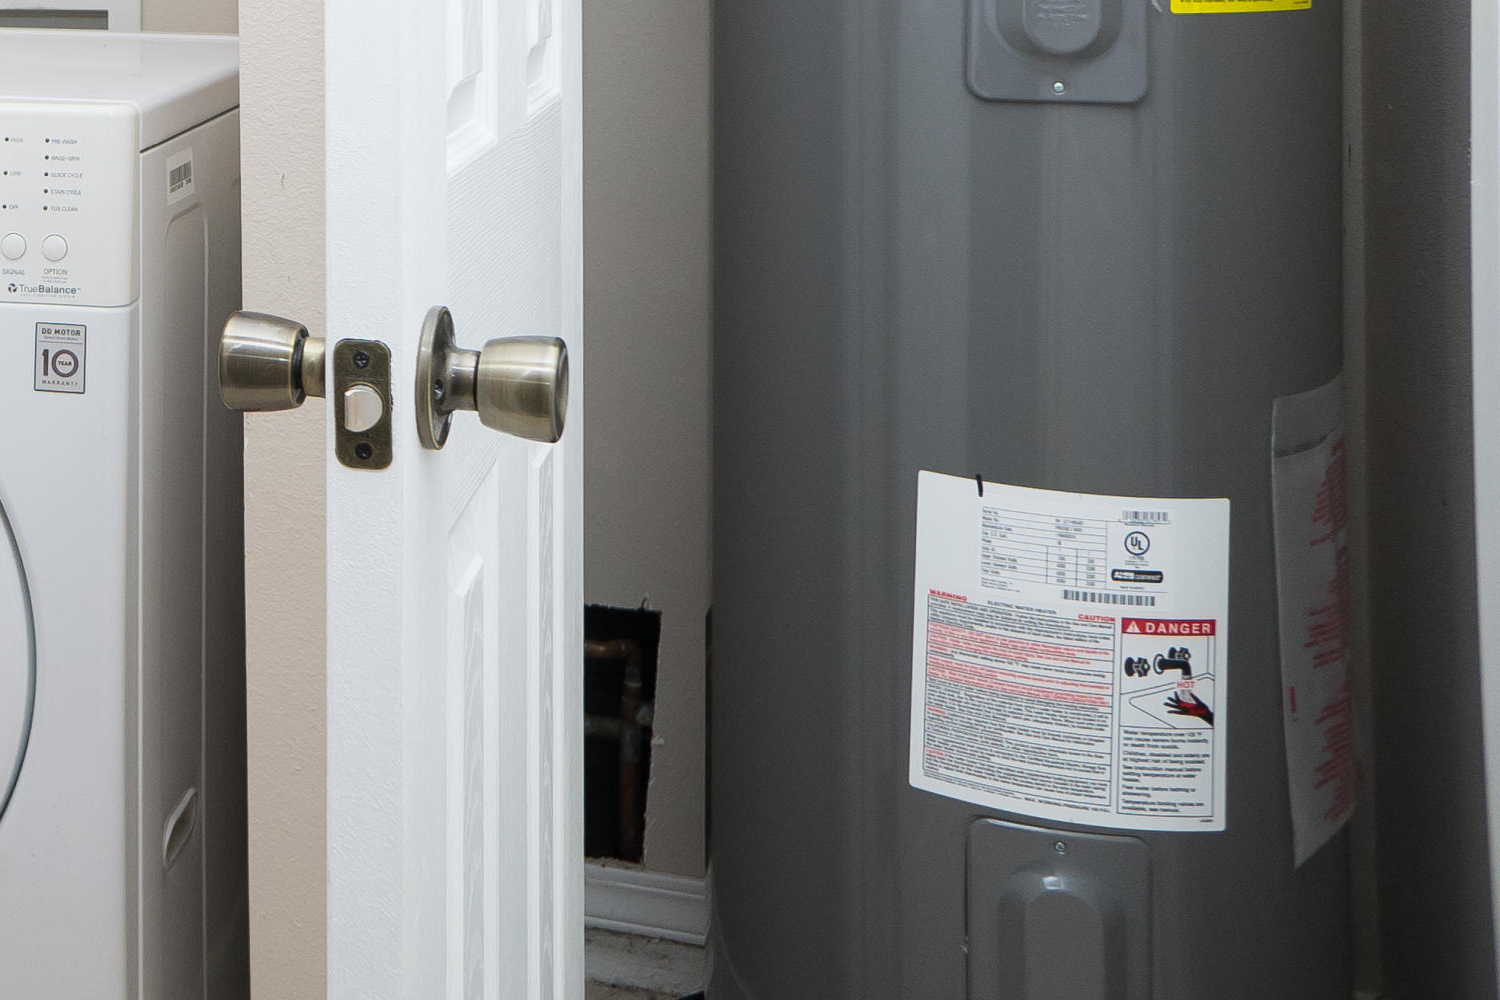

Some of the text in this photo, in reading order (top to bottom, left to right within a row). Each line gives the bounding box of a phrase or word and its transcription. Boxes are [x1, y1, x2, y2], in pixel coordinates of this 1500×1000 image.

[2, 268, 25, 276] SIGNAL
[44, 268, 68, 276] OPTION
[41, 327, 81, 336] DD MOTOR
[42, 348, 79, 378] 10
[42, 379, 79, 387] WARRANTY
[1130, 536, 1144, 551] UL
[929, 587, 968, 602] WARNING
[1077, 613, 1116, 622] CAUTION
[1145, 622, 1211, 634] DANGER
[1177, 681, 1196, 689] HOT
